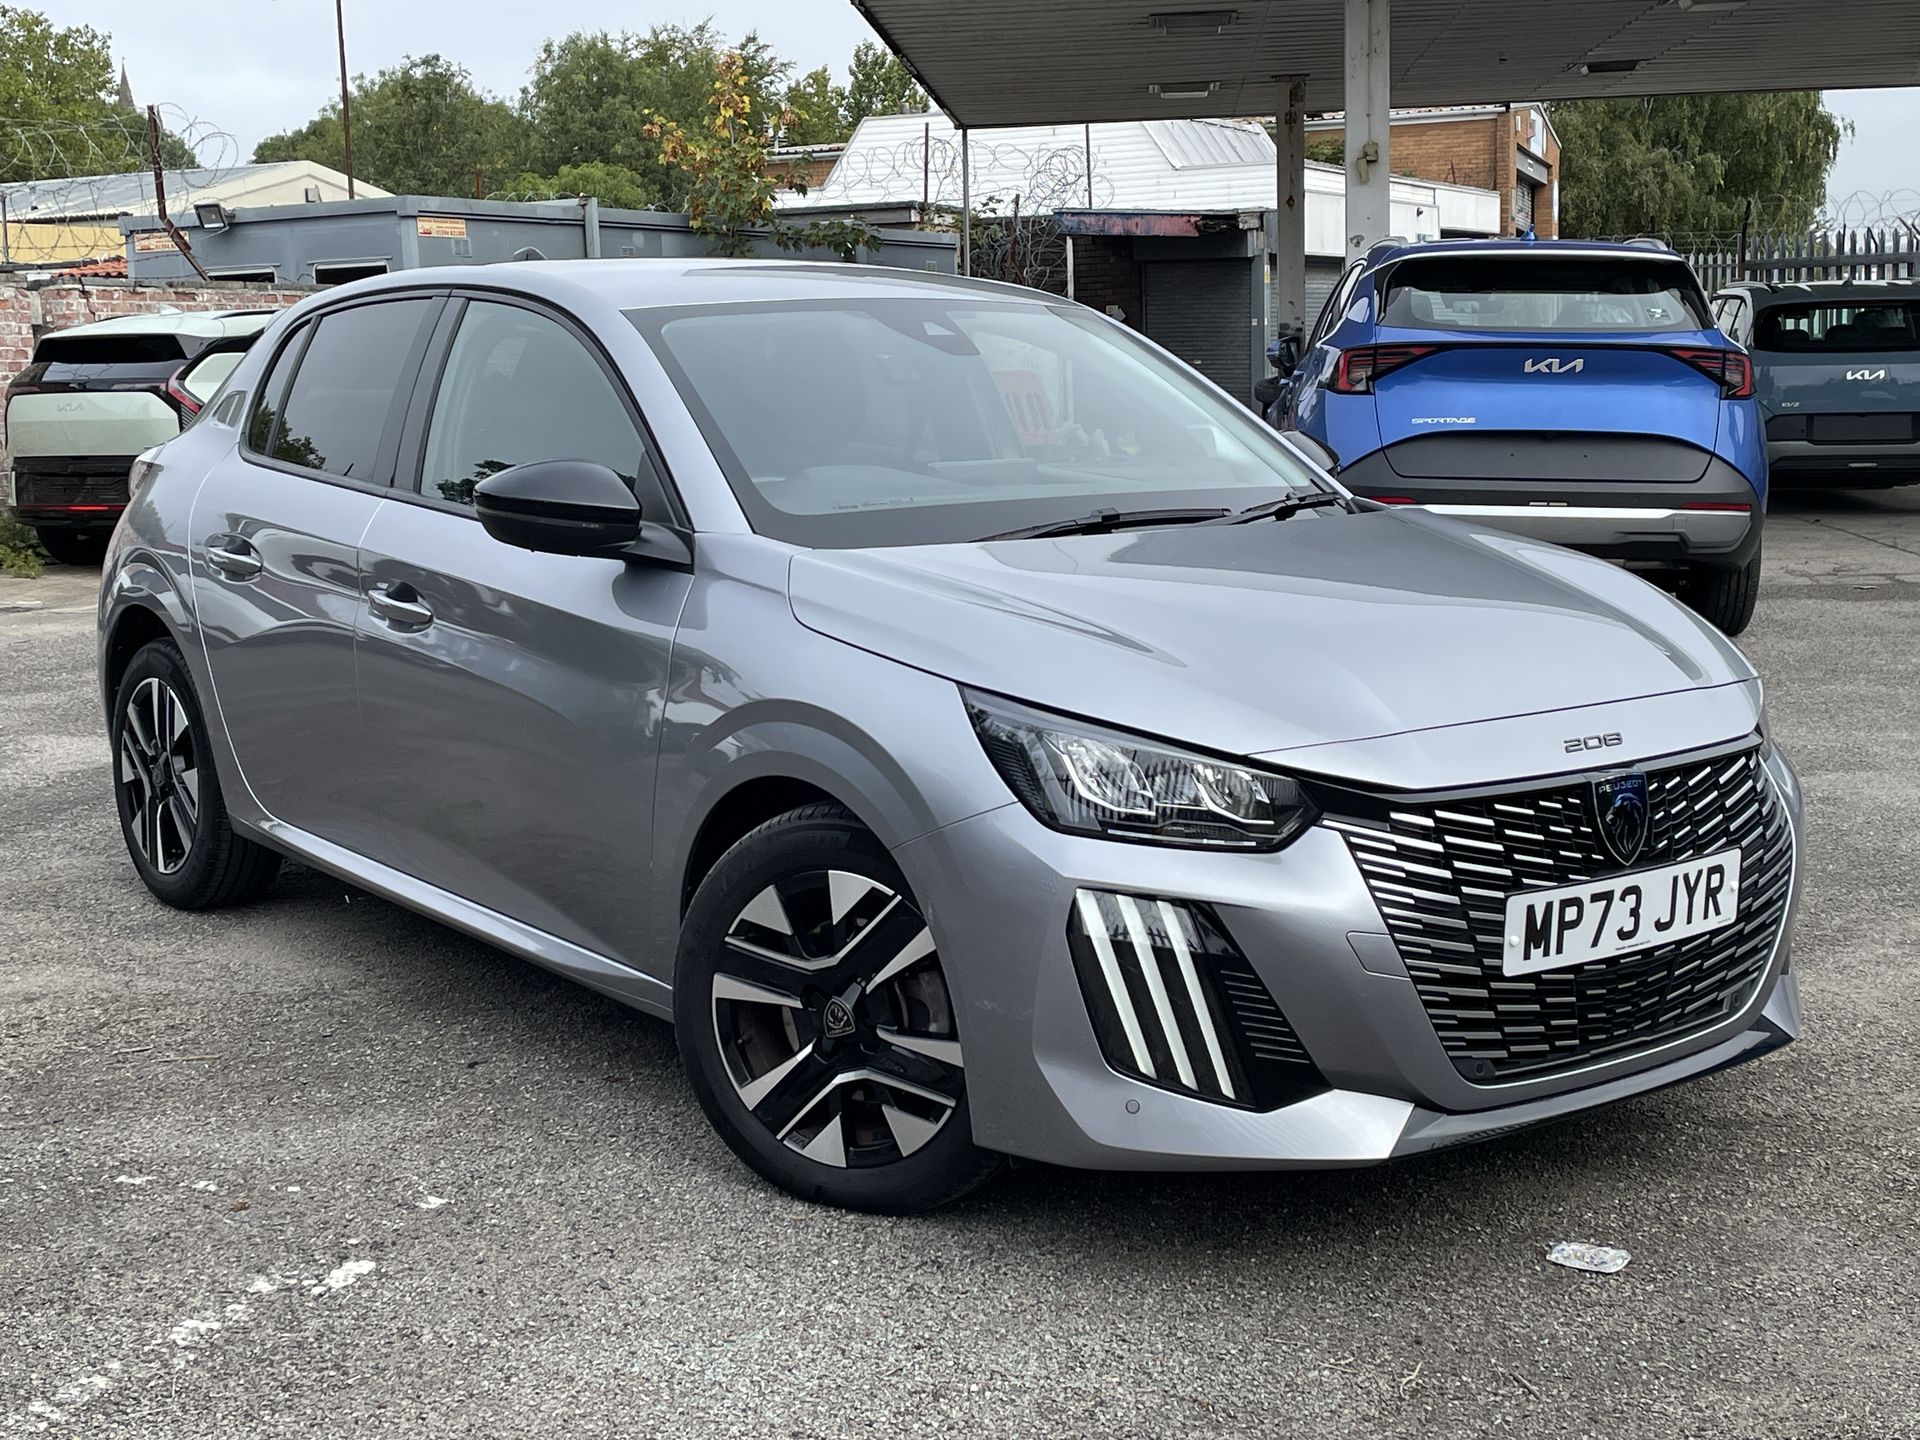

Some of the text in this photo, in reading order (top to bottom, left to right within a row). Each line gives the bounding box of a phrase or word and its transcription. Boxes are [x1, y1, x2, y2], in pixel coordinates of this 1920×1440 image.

[1524, 358, 1584, 373] KIA
[1846, 369, 1886, 380] KIA
[1563, 732, 1623, 753] 208
[1598, 779, 1643, 794] PEUGEOT
[1523, 863, 1725, 961] MP73 JYR
